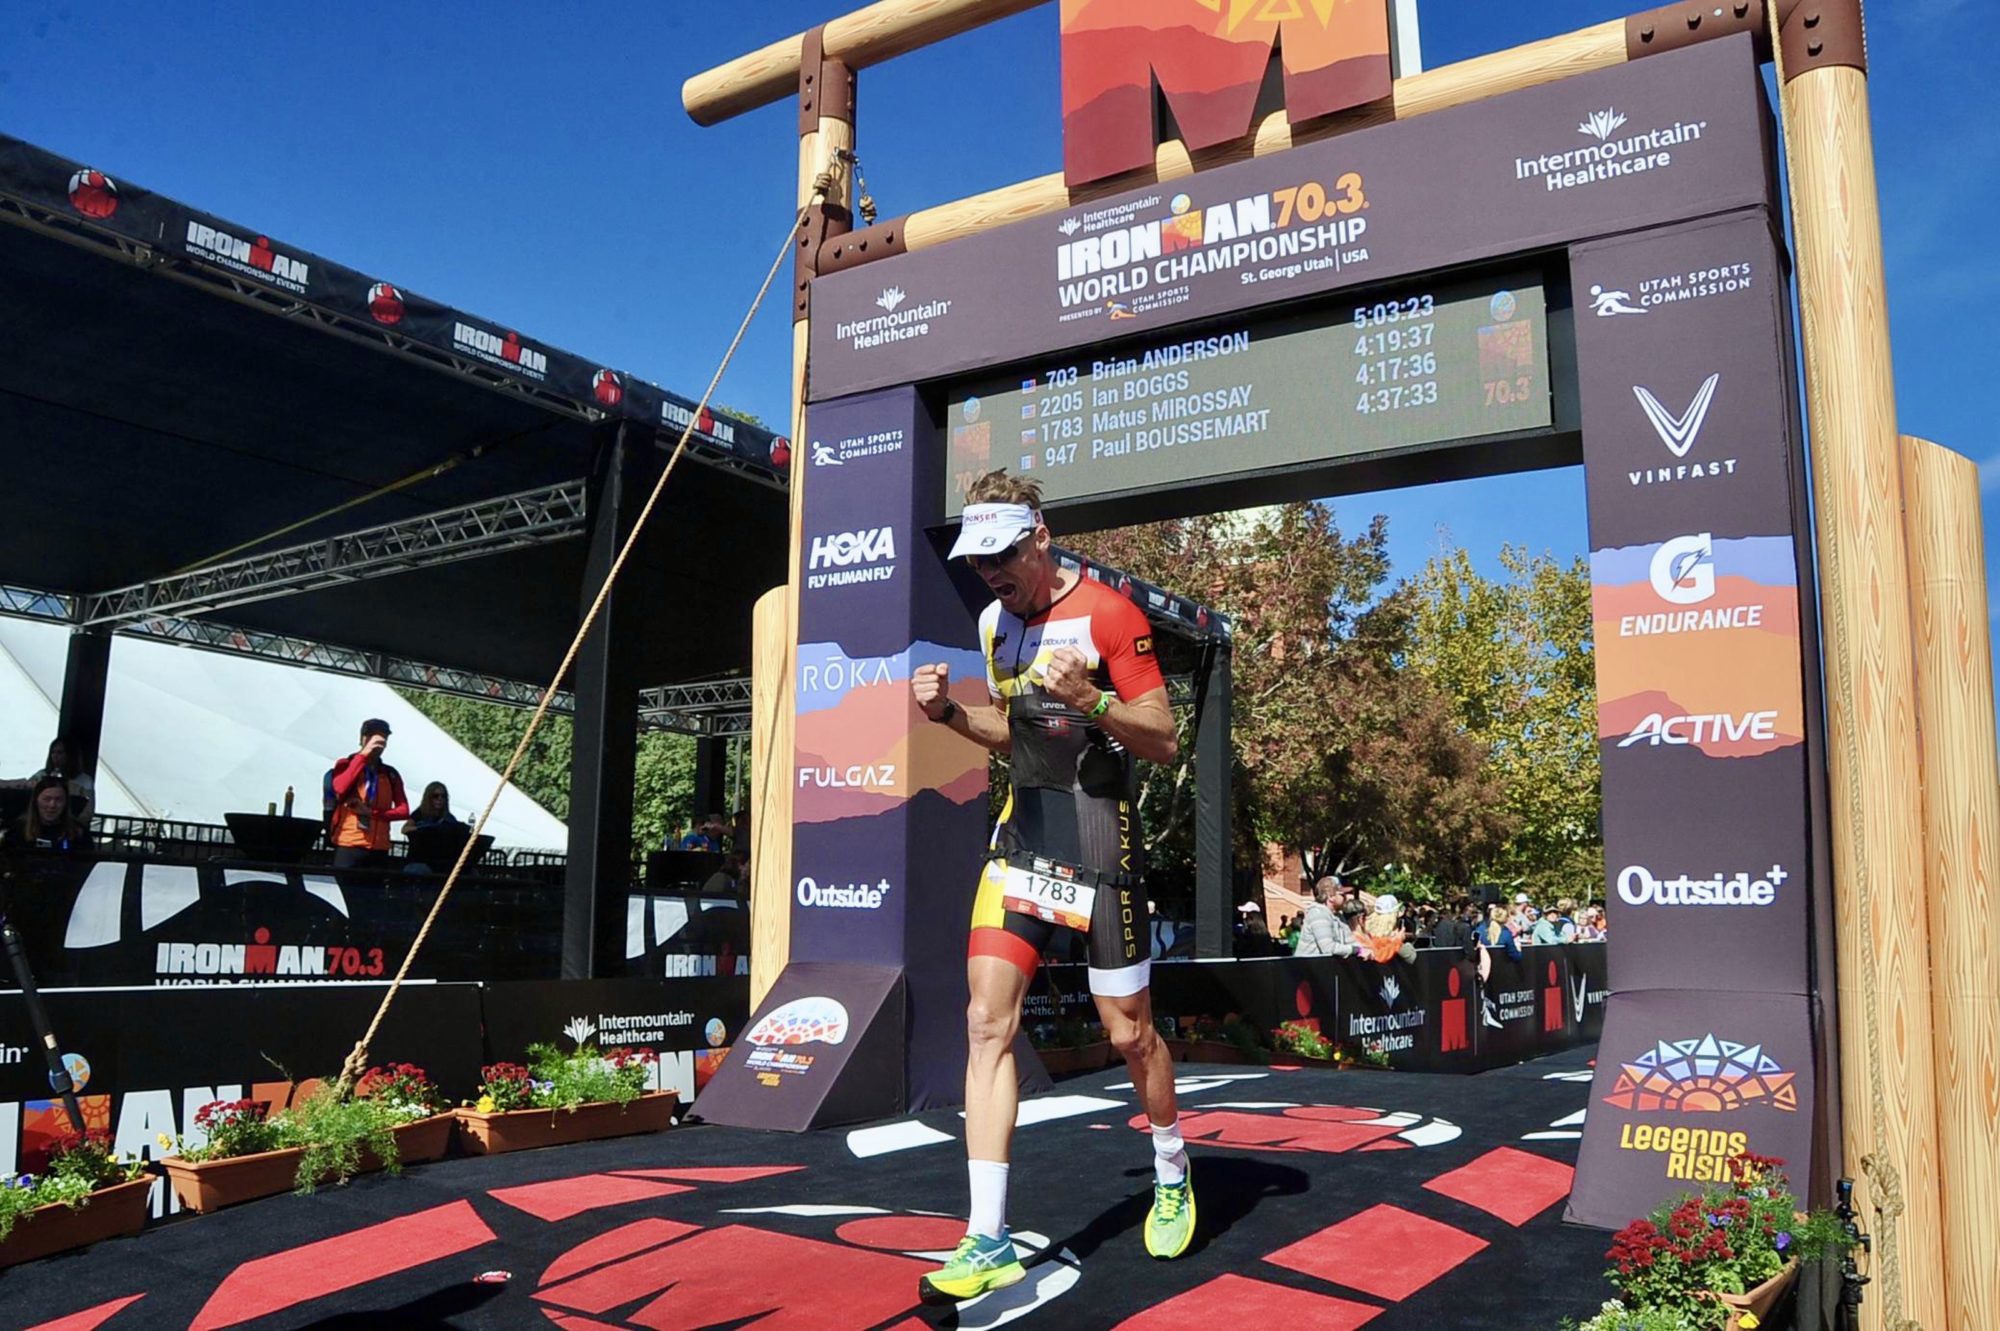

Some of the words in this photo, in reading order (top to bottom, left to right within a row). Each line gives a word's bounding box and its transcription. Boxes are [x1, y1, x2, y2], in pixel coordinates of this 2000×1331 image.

[1515, 120, 1706, 179] Intermountain
[1546, 152, 1671, 191] Healthcare
[1083, 195, 1161, 223] Intermountain
[1273, 172, 1367, 228] 70.3
[1083, 213, 1135, 233] Healthcare
[186, 220, 309, 285] IRONMAN
[1058, 267, 1148, 308] WORLD
[1154, 217, 1367, 284] CHAMPIONSHIP
[1240, 271, 1258, 285] St.
[1260, 264, 1302, 281] George
[1304, 256, 1333, 273] Utah
[1342, 248, 1369, 265] USA
[186, 244, 216, 261] WORLD
[216, 256, 276, 282] CHAMPIONSHIP
[276, 277, 306, 295] EVENTS
[1639, 275, 1682, 293] UTAH
[1688, 262, 1751, 284] SPORTS
[1132, 294, 1155, 305] UTAH
[1157, 285, 1189, 299] SPORTS
[1132, 294, 1190, 314] COMMISSION
[1640, 277, 1751, 308] COMMISSION
[836, 299, 952, 341] Intermountain
[1059, 309, 1094, 323] PRESENTED
[1094, 307, 1103, 316] BY
[453, 322, 548, 374] IRONMAN
[854, 323, 929, 350] Healthcare
[1046, 366, 1078, 391] 703
[1092, 357, 1138, 382] Brian
[1142, 331, 1250, 370] ANDERSON
[1353, 294, 1435, 329] 5:03:23
[1040, 391, 1083, 418] 2205
[1092, 385, 1119, 408] Ian
[1123, 371, 1190, 401] BOGGS
[1354, 323, 1436, 357] 4:19:37
[1041, 417, 1083, 443] 1783
[1092, 408, 1147, 433] Matus
[1151, 384, 1253, 423] MIROSSAY
[1355, 351, 1437, 386] 4:17:36
[1483, 375, 1531, 406] 70.3
[1045, 443, 1078, 467] 947
[1092, 433, 1131, 459] Paul
[1135, 409, 1271, 452] BOUSSEMART
[1355, 381, 1438, 414] 4:37:33
[839, 441, 904, 460] COMMISSION
[840, 436, 865, 450] UTAH
[867, 430, 903, 446] SPORTS
[1628, 459, 1737, 485] VINFAST
[808, 526, 897, 570] HOKA
[808, 573, 828, 589] FLY
[828, 568, 873, 587] HUMAN
[873, 565, 897, 581] FLY
[1619, 605, 1764, 637] ENDURANCE
[1616, 710, 1779, 748] ACTIVE
[799, 764, 896, 788] FULGAZ
[1026, 875, 1077, 904] 1783
[155, 927, 328, 975] IRONMAN
[328, 947, 384, 976] 70.3
[599, 1010, 695, 1031] Intermountain
[599, 1030, 665, 1045] Healthcare
